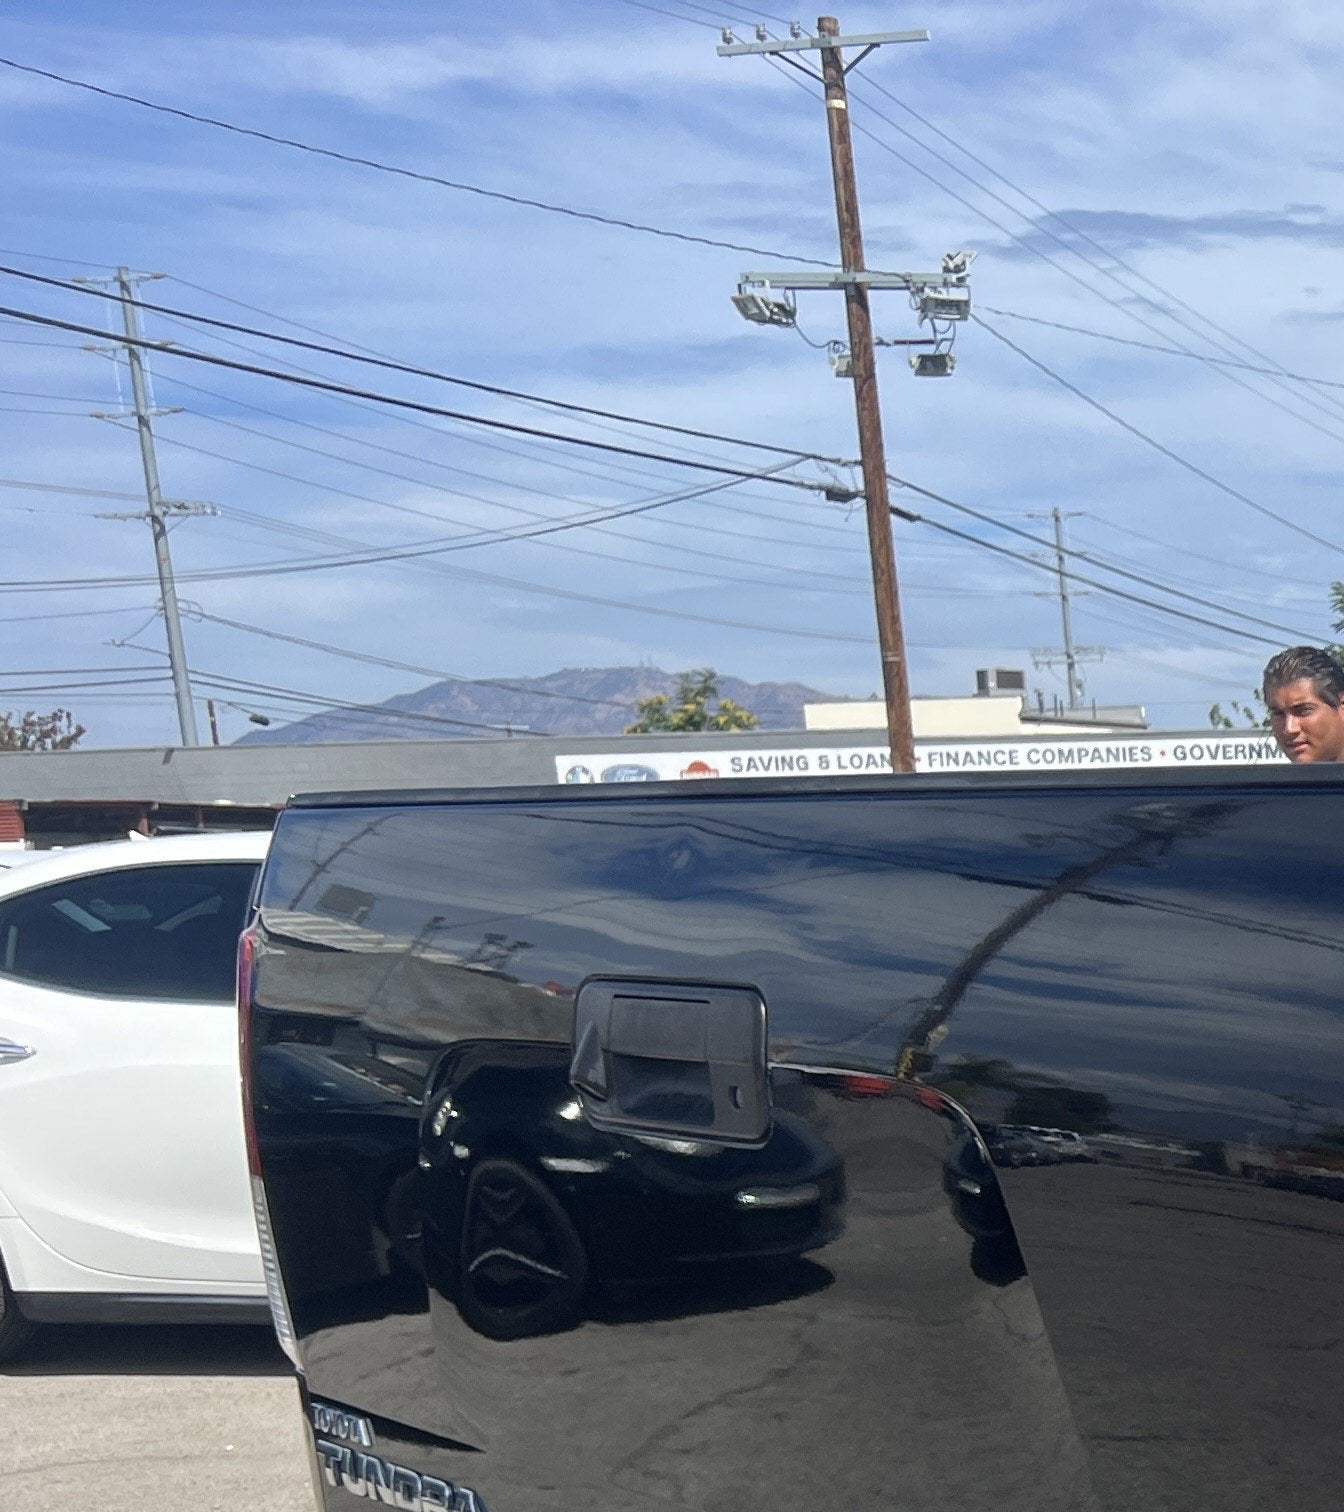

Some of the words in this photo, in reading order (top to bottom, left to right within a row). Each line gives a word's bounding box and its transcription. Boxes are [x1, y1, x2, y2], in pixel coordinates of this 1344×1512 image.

[731, 754, 809, 773] SAVING
[818, 755, 830, 770] &
[928, 749, 1018, 767] FINANCE
[1027, 746, 1152, 765] COMPANIES
[1173, 743, 1283, 760] GOVERNM
